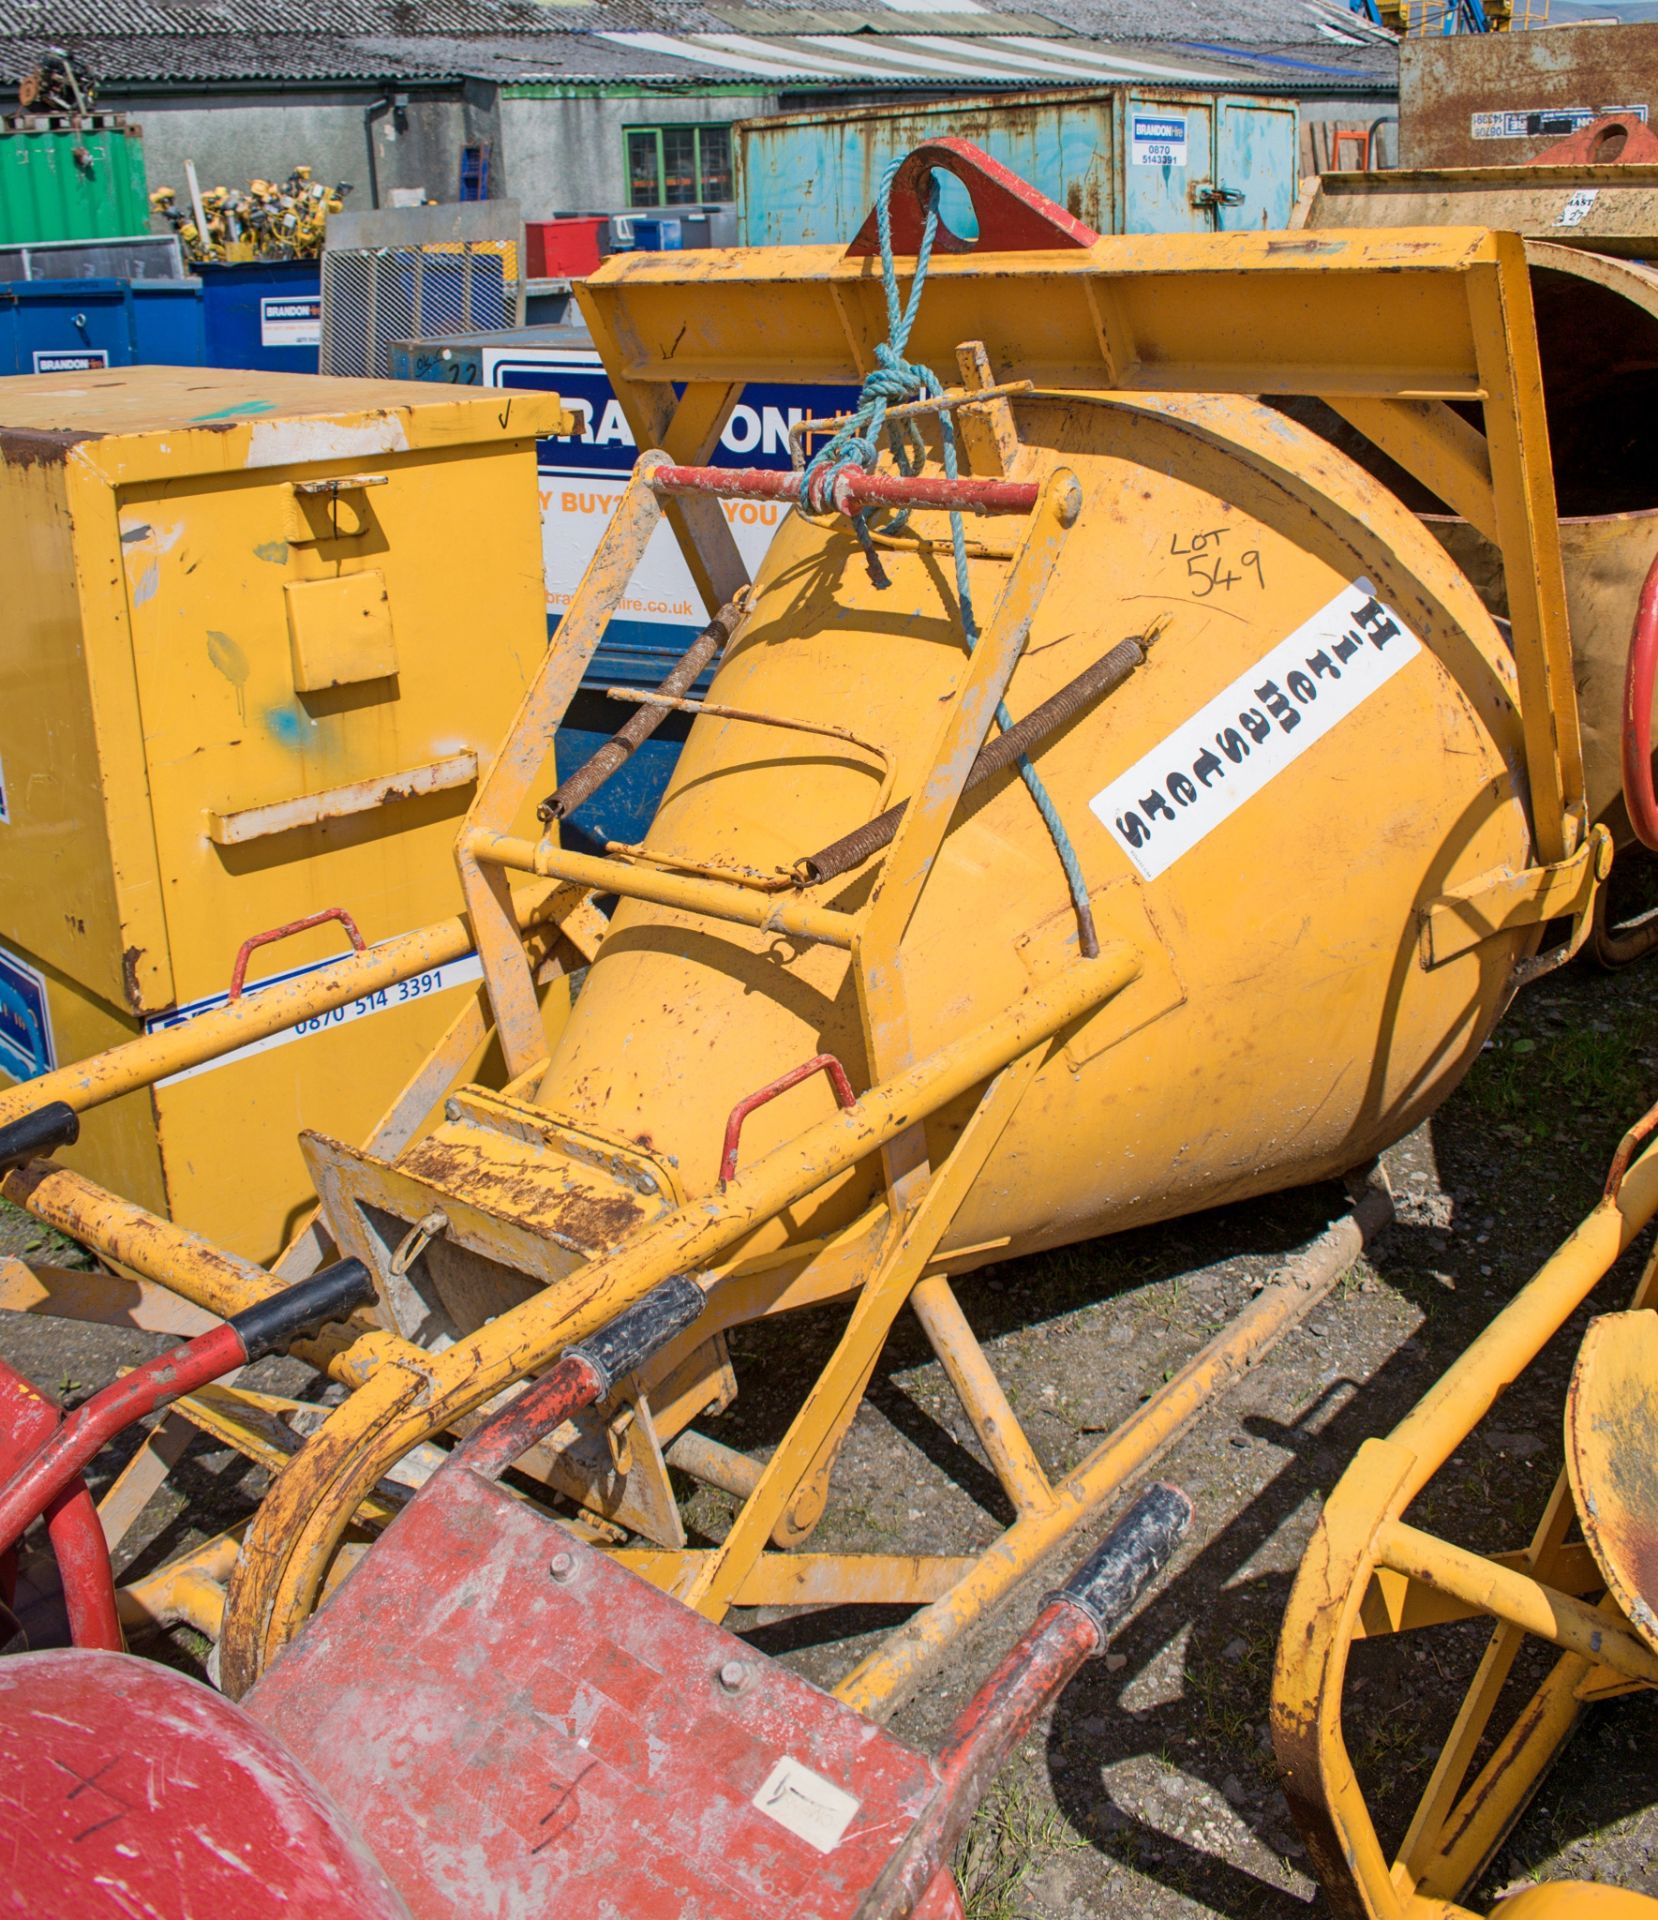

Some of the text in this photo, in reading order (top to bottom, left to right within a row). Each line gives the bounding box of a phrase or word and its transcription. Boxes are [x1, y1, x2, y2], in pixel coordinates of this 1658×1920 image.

[1142, 155, 1177, 165] 5143391
[1149, 145, 1171, 155] 0870
[723, 502, 778, 526] YOU
[1170, 528, 1231, 555] LOT
[1187, 550, 1265, 597] 549
[1115, 597, 1401, 850] Hiremasters
[355, 989, 388, 1015] 514
[398, 970, 442, 1001] 3391
